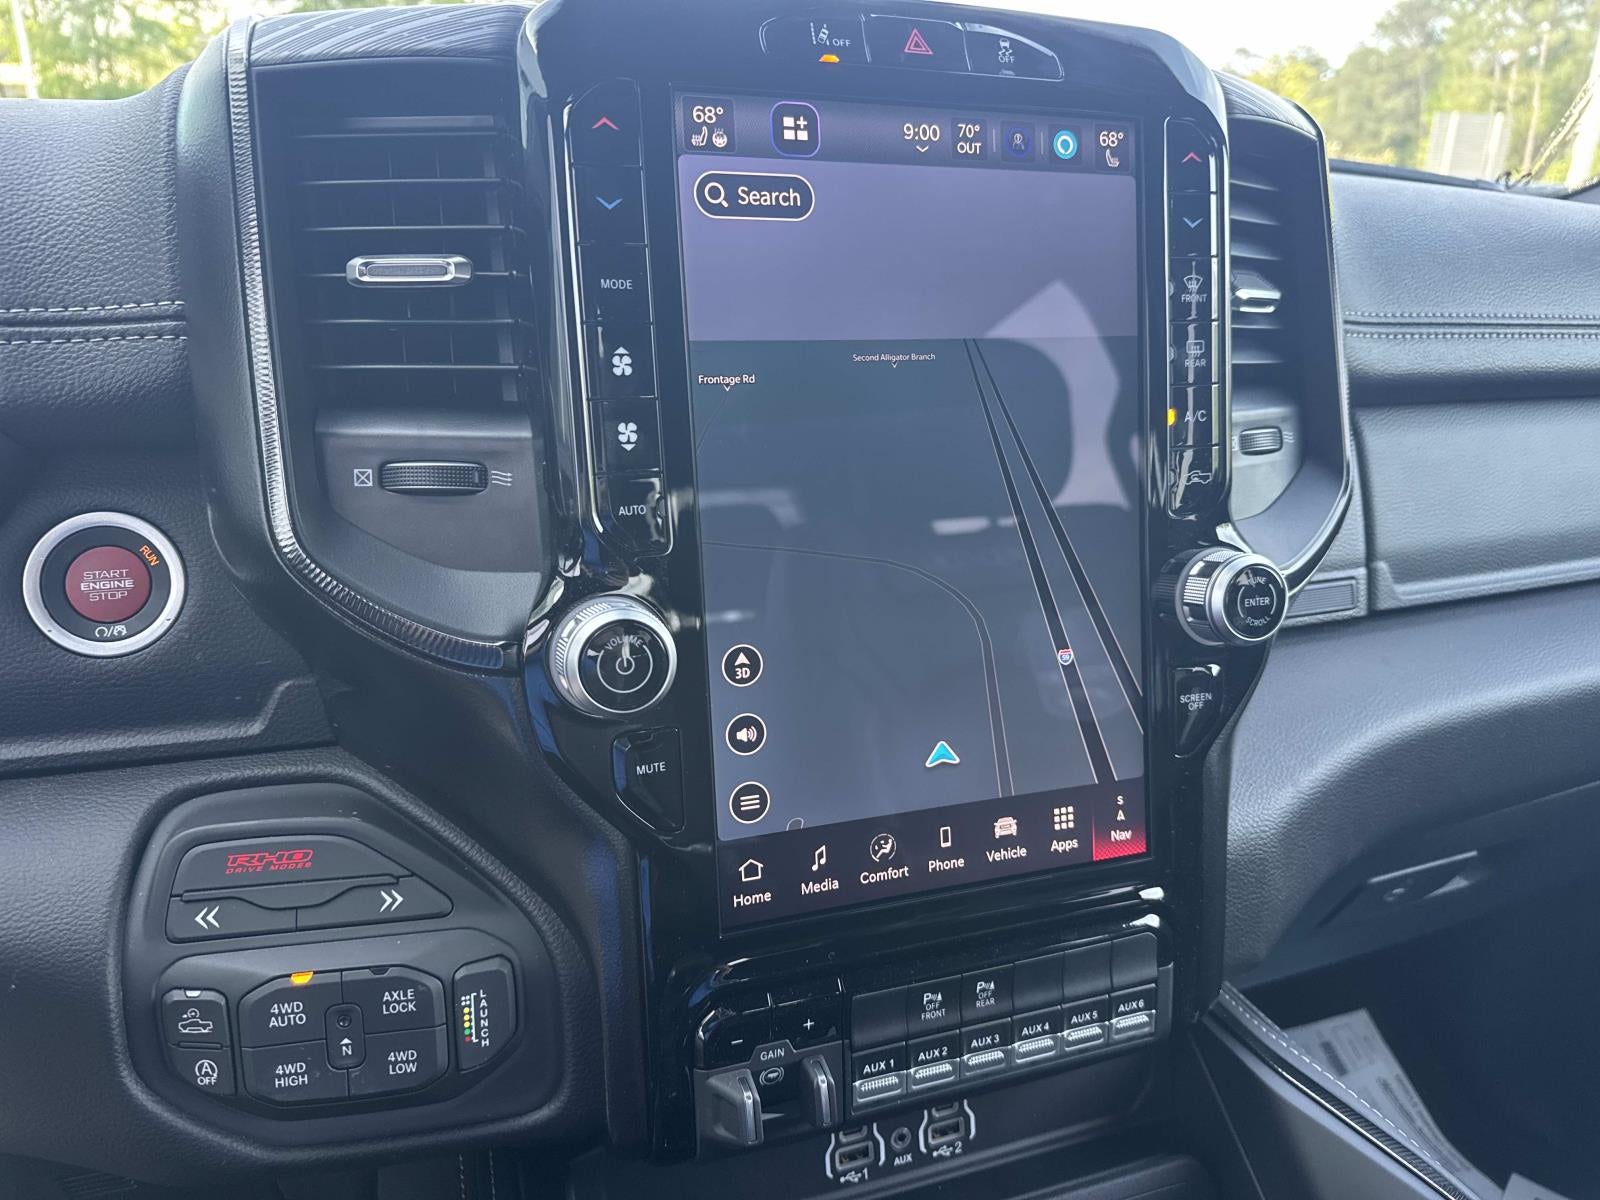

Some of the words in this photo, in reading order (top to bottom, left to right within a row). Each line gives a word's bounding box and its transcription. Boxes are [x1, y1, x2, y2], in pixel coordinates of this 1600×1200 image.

[832, 38, 852, 48] OFF
[998, 55, 1015, 64] OFF
[692, 106, 724, 124] 68°
[903, 123, 940, 142] 9:00
[957, 124, 981, 138] 70°
[1099, 131, 1124, 147] 68°
[957, 142, 982, 155] OUT
[737, 186, 801, 207] Search
[600, 279, 633, 290] MODE
[1181, 294, 1207, 303] FRONT
[852, 353, 879, 362] Second
[880, 353, 910, 362] Alligator
[911, 352, 936, 361] Branch
[1184, 359, 1206, 368] REAR
[698, 374, 741, 386] Frontage
[742, 374, 756, 384] Rd
[1184, 410, 1207, 422] A/C
[618, 504, 647, 516] AUTO
[139, 545, 160, 567] RUN
[83, 569, 129, 580] START
[80, 579, 135, 591] ENGINE
[89, 590, 128, 601] STOP
[1244, 596, 1270, 607] ENTER
[1245, 615, 1271, 626] SCROLL
[735, 667, 751, 680] 3D
[1179, 692, 1213, 704] SCREEN
[1188, 702, 1204, 711] OFF
[636, 762, 667, 775] MUTE
[1110, 829, 1133, 842] Nav
[1050, 838, 1079, 853] Apps
[227, 849, 313, 867] RHO
[986, 846, 1028, 863] Vehicle
[225, 866, 264, 875] DRIVE
[269, 862, 312, 871] MODES
[928, 857, 965, 873] Phone
[860, 865, 910, 885] Comfort
[801, 878, 840, 896] Media
[733, 892, 772, 908] Home
[382, 989, 416, 1002] AXLE
[978, 989, 993, 999] OFF
[270, 1002, 304, 1015] 4WD
[382, 1001, 417, 1015] LOCK
[926, 1002, 940, 1010] OFF
[976, 997, 995, 1008] REAR
[1117, 1001, 1137, 1013] AUX
[1137, 999, 1144, 1009] 6
[269, 1013, 306, 1028] AUTO
[479, 989, 490, 1047] LAUNCH
[921, 1009, 946, 1020] FRONT
[1070, 1013, 1090, 1024] AUX
[1091, 1010, 1098, 1021] 5
[1021, 1024, 1042, 1036] AUX
[1043, 1021, 1050, 1032] 4
[970, 1037, 991, 1049] AUX
[993, 1033, 1000, 1044] 3
[342, 1045, 352, 1056] N
[387, 1050, 417, 1063] 4WD
[760, 1047, 785, 1061] GAIN
[918, 1049, 940, 1061] AUX
[942, 1046, 948, 1057] 2
[275, 1062, 307, 1076] 4WD
[388, 1062, 417, 1075] LOW
[863, 1062, 888, 1074] AUX
[889, 1058, 895, 1068] 1
[197, 1075, 217, 1086] OFF
[275, 1074, 309, 1088] HIGH
[954, 1141, 963, 1154] 2
[893, 1153, 913, 1166] AUX
[863, 1168, 869, 1181] 1
